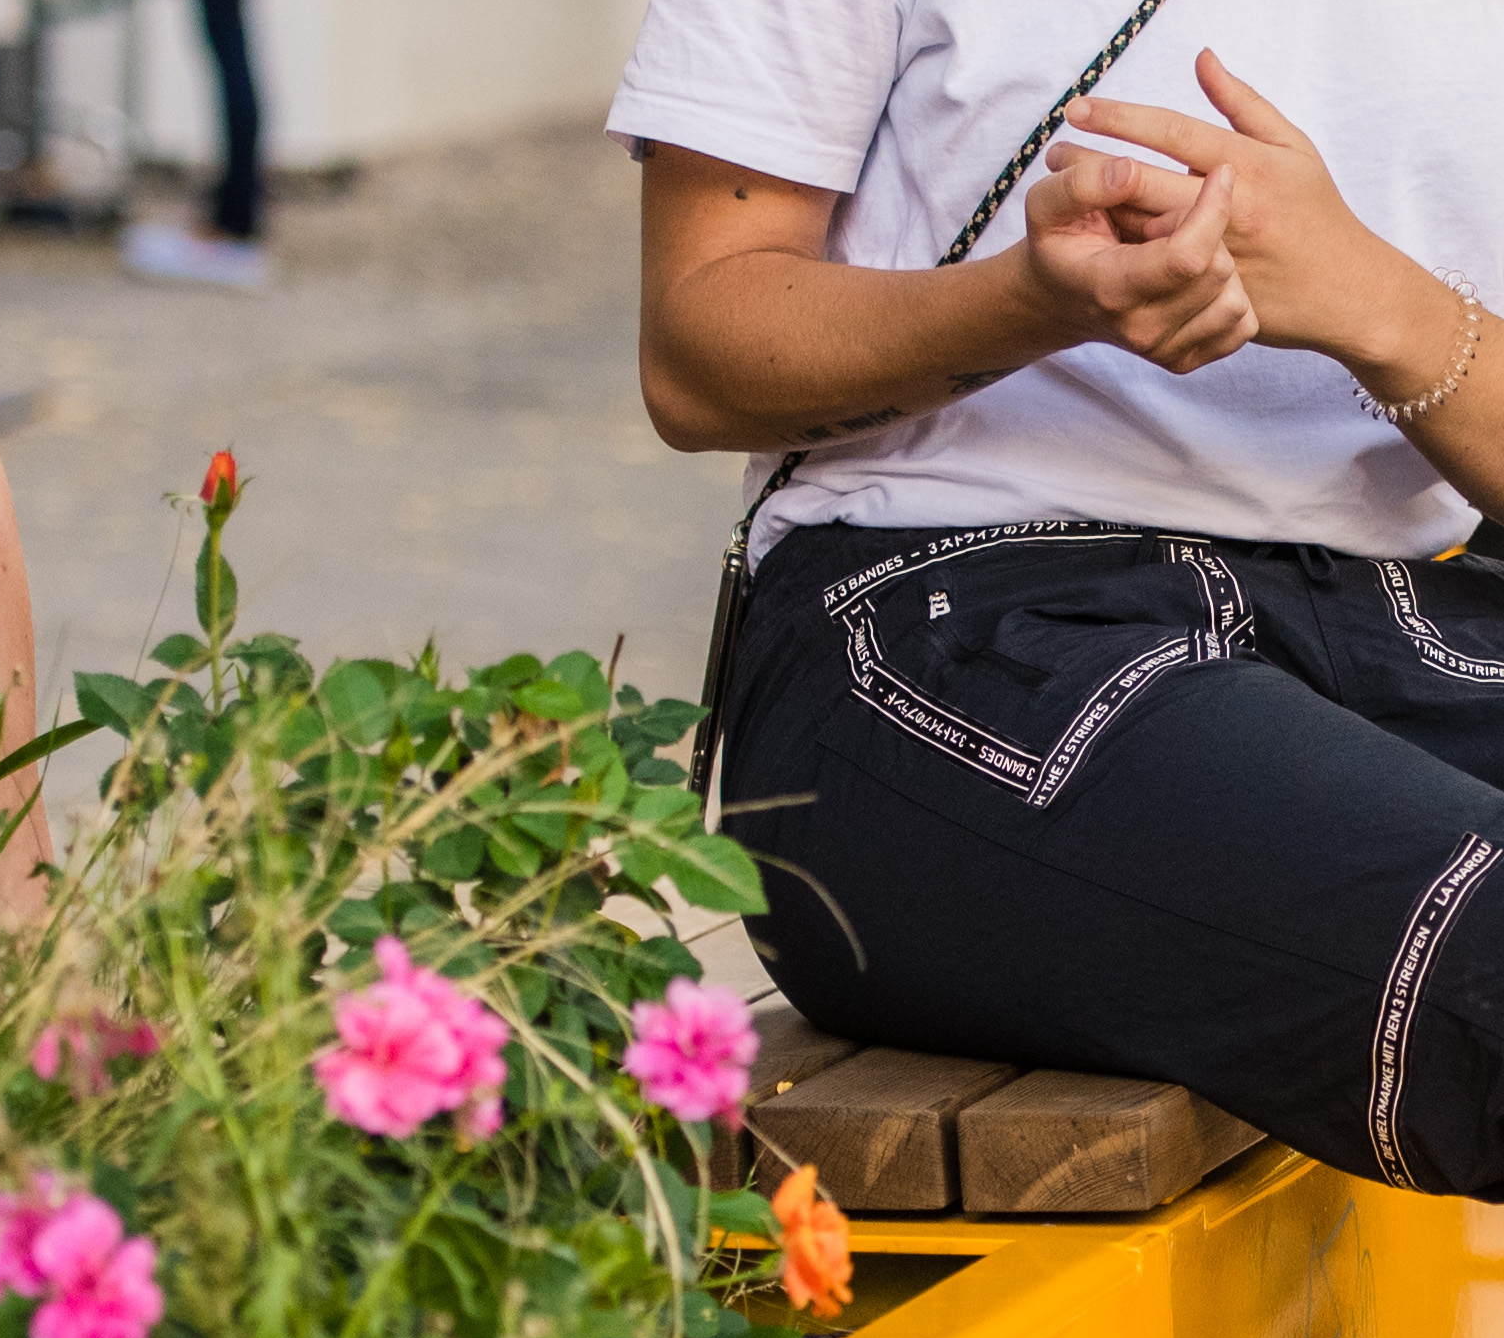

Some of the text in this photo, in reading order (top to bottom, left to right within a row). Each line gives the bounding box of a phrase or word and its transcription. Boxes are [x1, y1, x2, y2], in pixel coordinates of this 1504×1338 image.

[838, 584, 847, 597] 3
[848, 554, 905, 590] BANDES
[1383, 561, 1405, 587] DEN
[1395, 589, 1412, 614] MIT
[1422, 641, 1446, 665] THE
[1448, 656, 1457, 668] 3
[1041, 764, 1065, 793] THE
[1058, 754, 1070, 765] 3
[1064, 702, 1109, 755] STRIPES
[1118, 669, 1144, 689] DIE
[978, 744, 1028, 778] BANDES
[1458, 842, 1492, 887] MARQU
[1434, 886, 1455, 907] LA
[1395, 925, 1431, 998] STREIFEN
[1392, 998, 1406, 1010] 3
[1384, 1009, 1403, 1041] DEN
[1382, 1041, 1396, 1065] MIT
[1375, 1064, 1396, 1141] WELTMARKE
